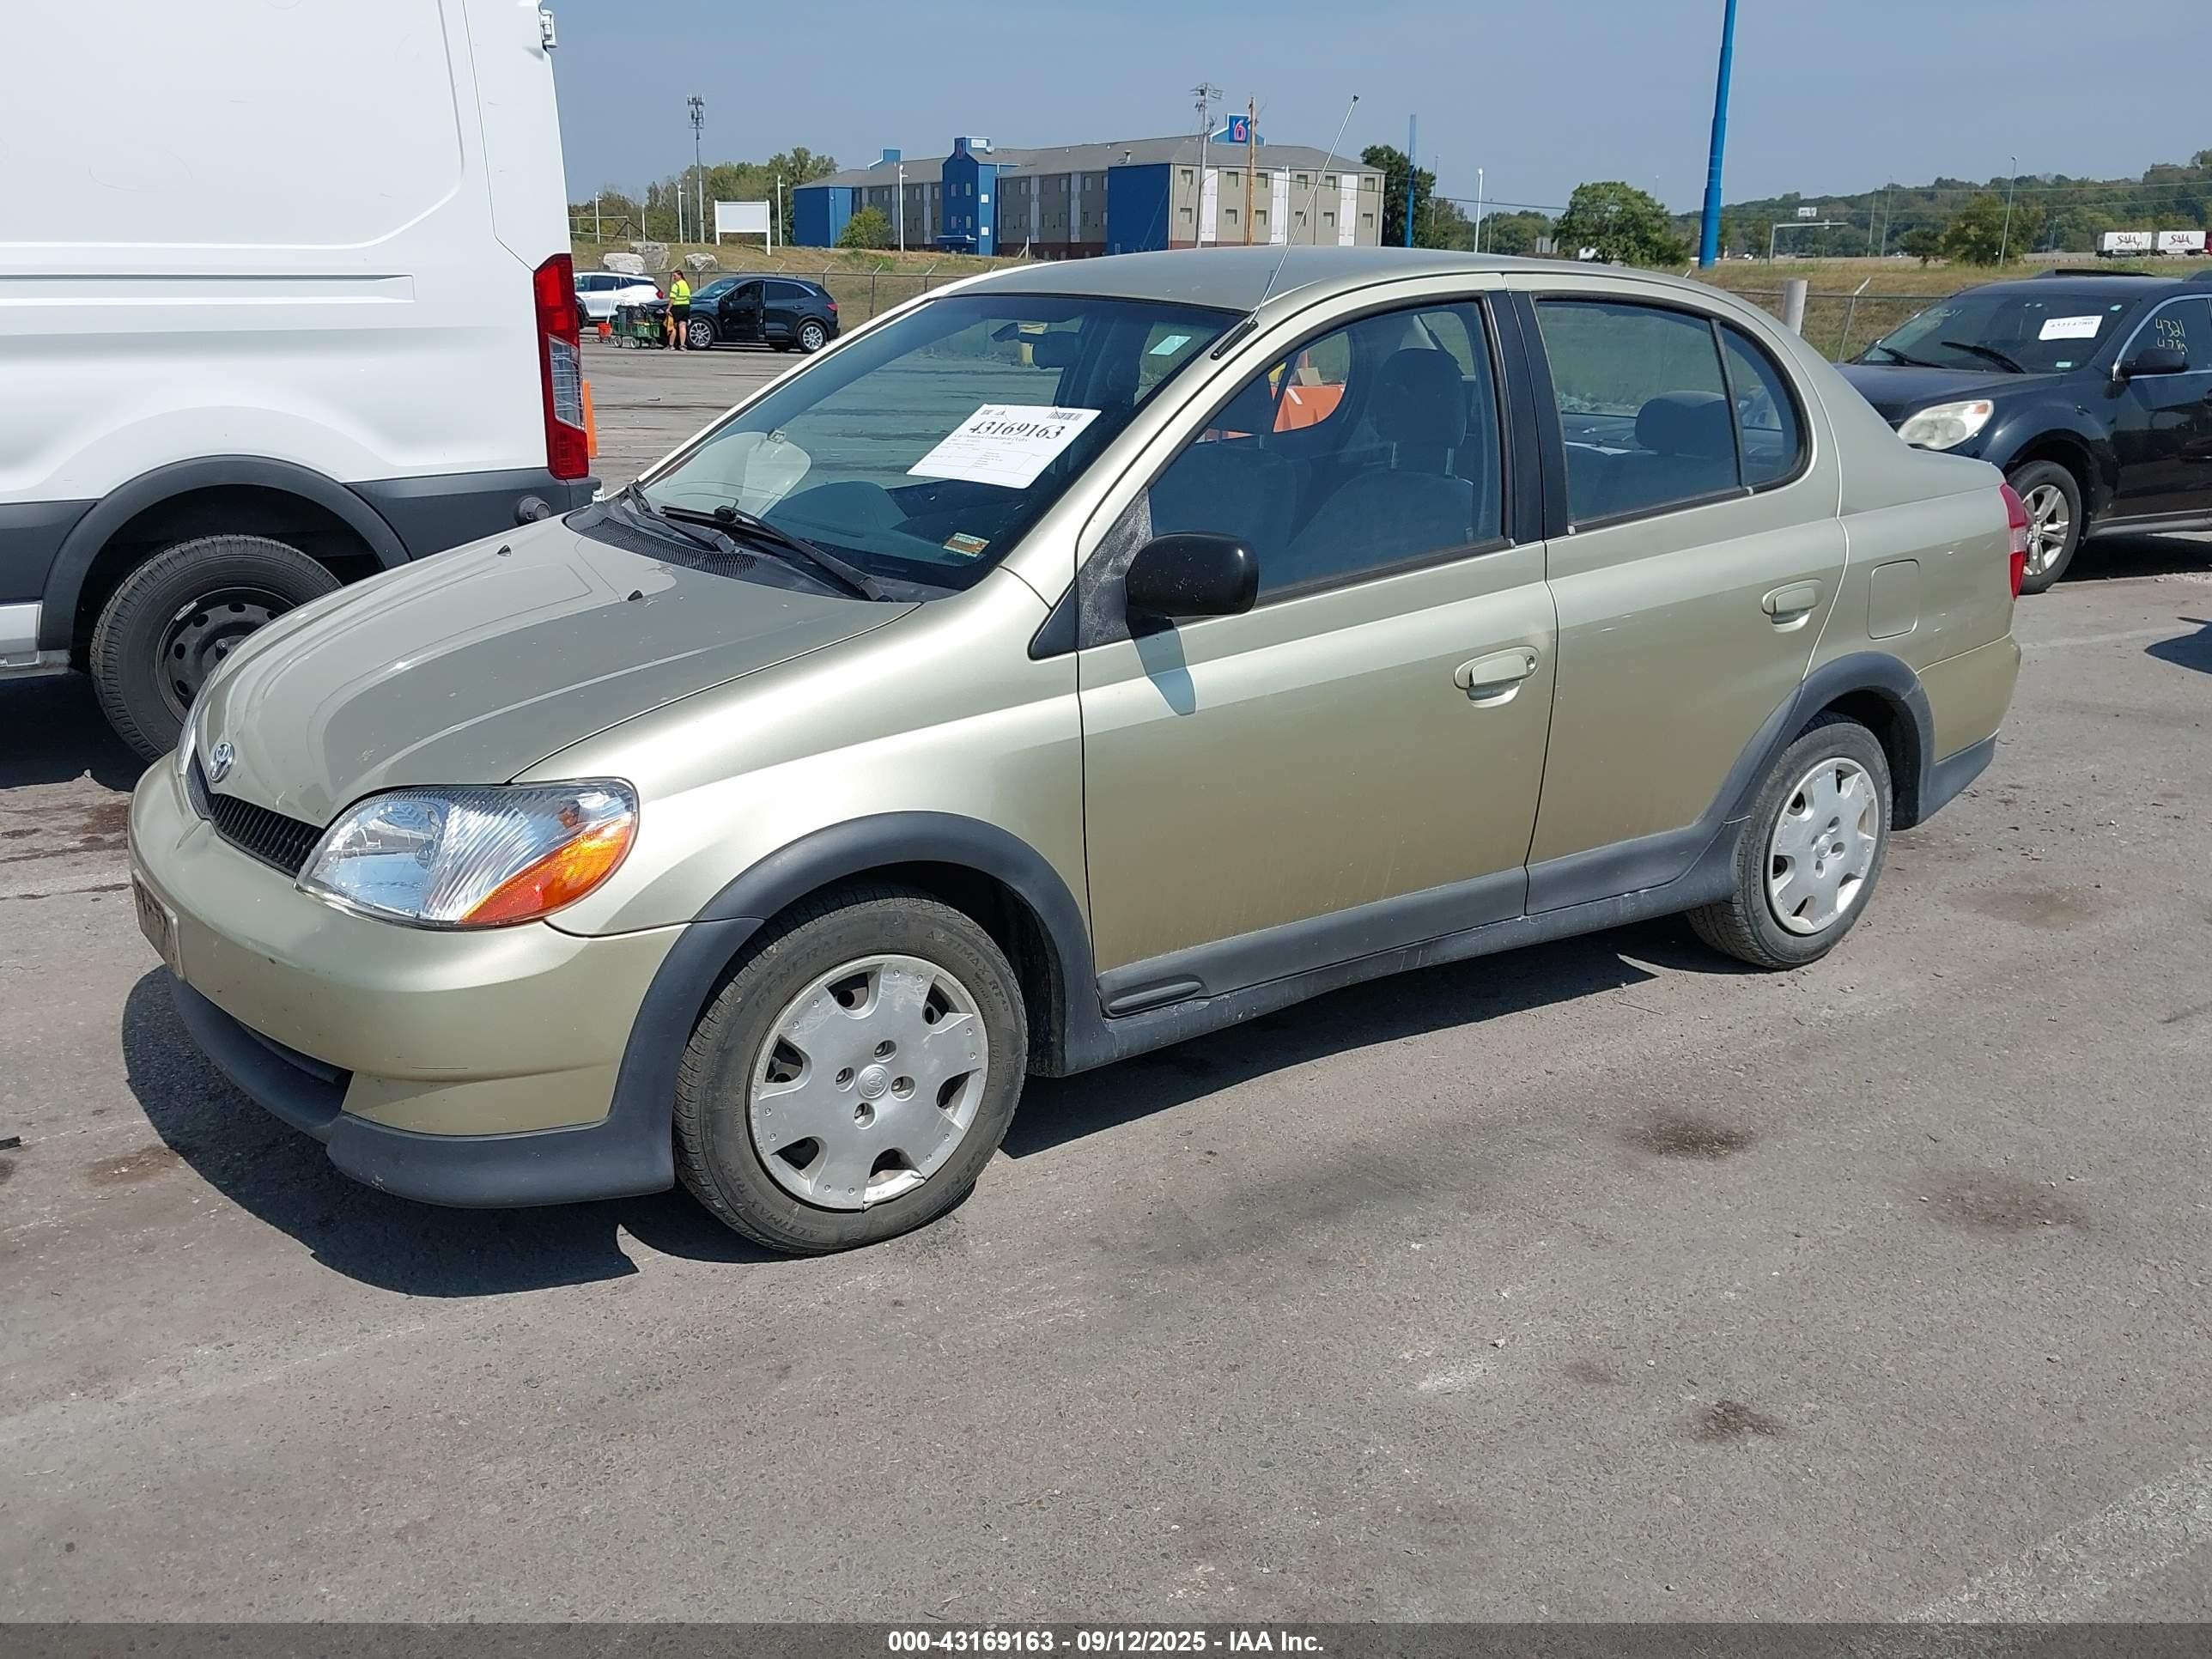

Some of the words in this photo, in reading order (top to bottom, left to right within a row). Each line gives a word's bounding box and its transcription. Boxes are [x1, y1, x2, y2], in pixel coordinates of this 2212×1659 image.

[1234, 119, 1247, 142] 6
[2155, 318, 2186, 338] 4321
[969, 421, 1066, 440] 43169163
